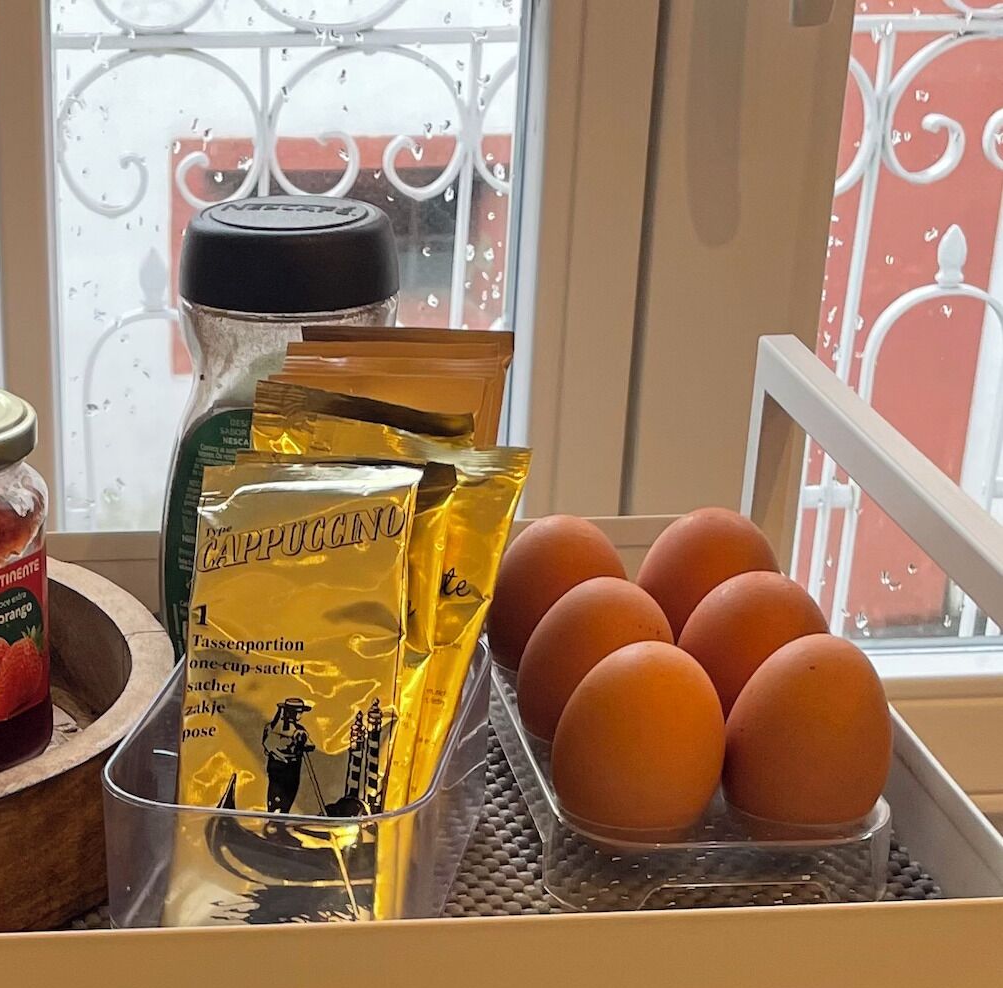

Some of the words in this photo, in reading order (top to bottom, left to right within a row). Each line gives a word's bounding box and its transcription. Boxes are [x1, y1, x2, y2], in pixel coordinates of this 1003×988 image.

[222, 436, 250, 446] NESCA
[196, 503, 406, 572] CAPPUCCINO
[205, 525, 233, 538] Type
[193, 604, 208, 626] 1
[193, 634, 304, 655] Tassenportion
[189, 658, 306, 676] one-cup-sachet
[186, 679, 236, 693] sachet
[184, 701, 226, 717] zakje
[182, 725, 217, 743] pose
